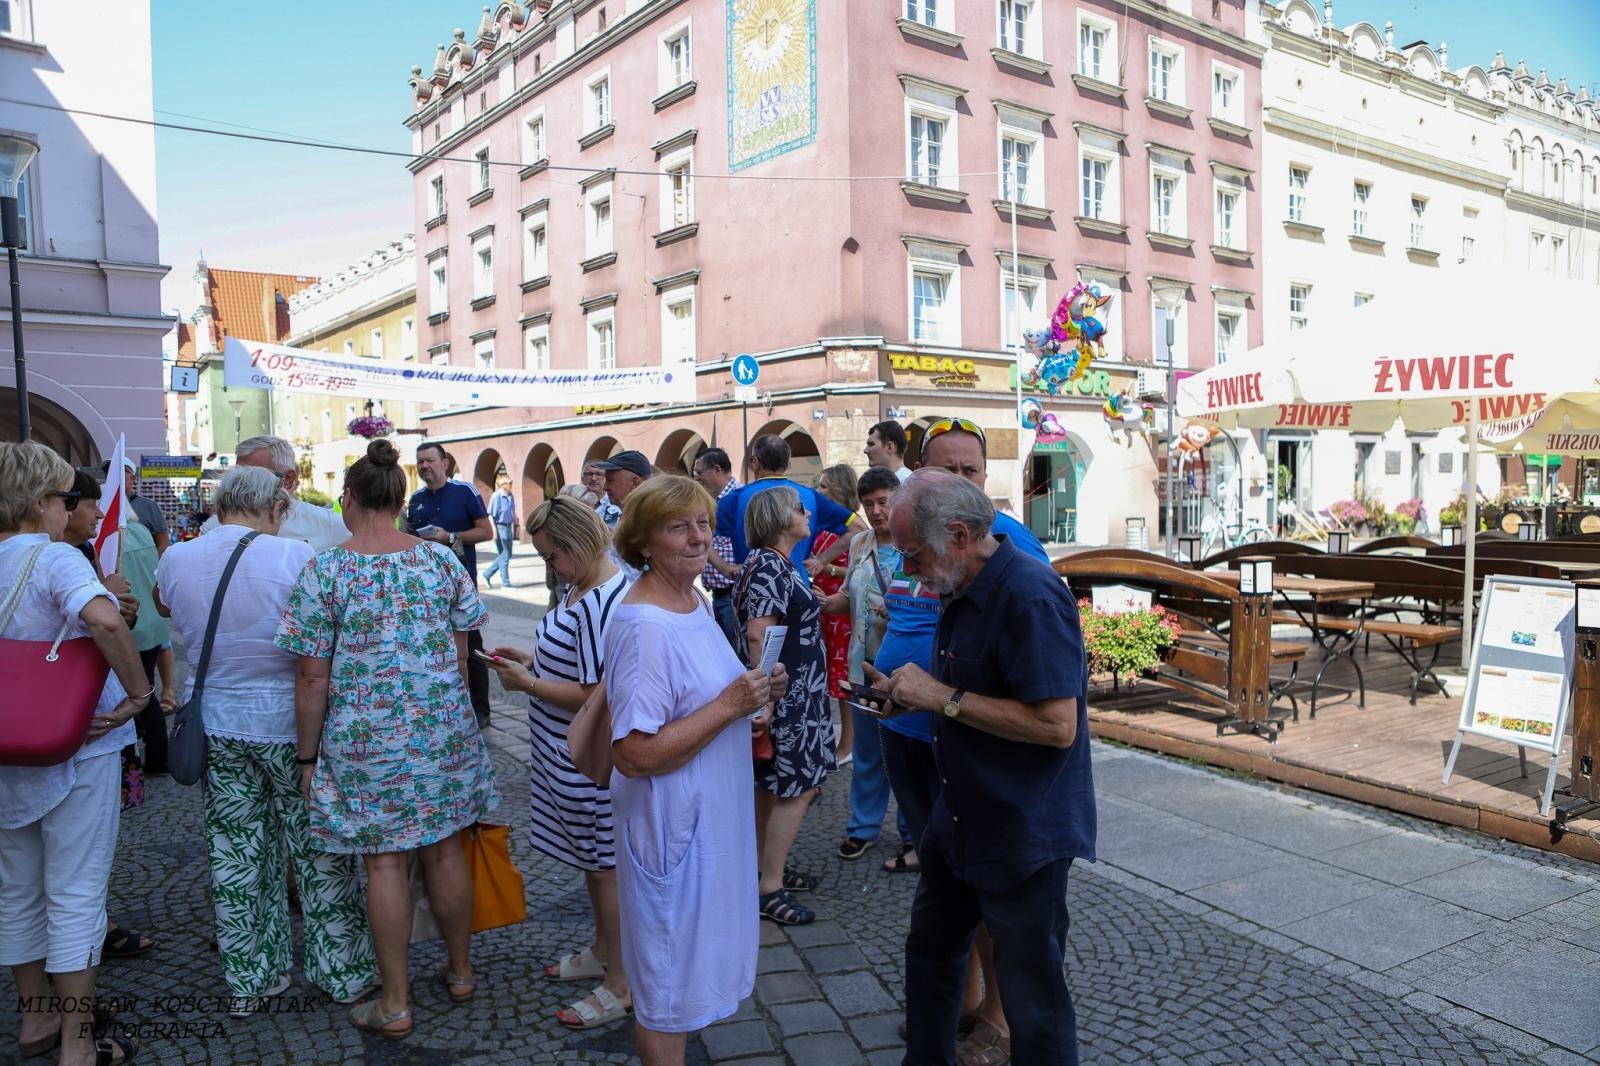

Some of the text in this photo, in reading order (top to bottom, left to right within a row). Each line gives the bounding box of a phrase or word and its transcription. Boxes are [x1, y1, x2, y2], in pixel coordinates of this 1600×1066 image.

[889, 353, 975, 374] TABAC
[1375, 353, 1514, 392] ŻYWIEC
[1207, 372, 1264, 408] ŻYWIEC
